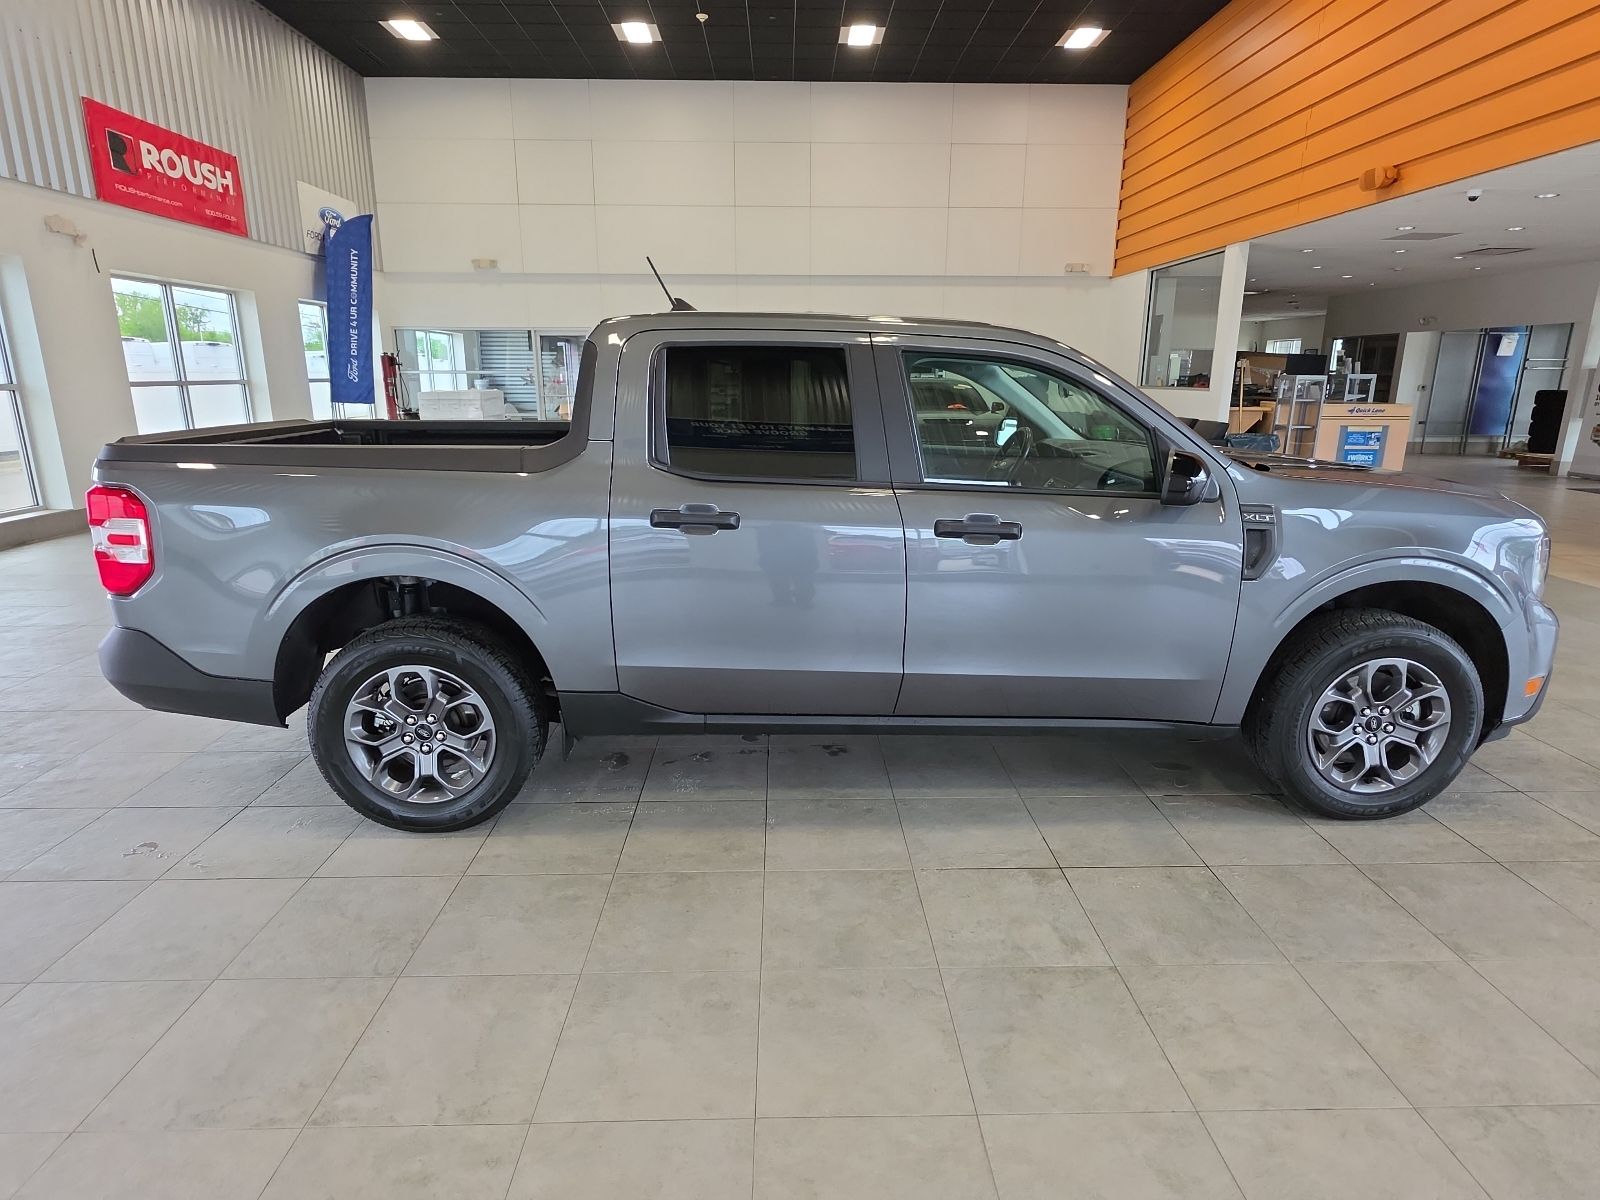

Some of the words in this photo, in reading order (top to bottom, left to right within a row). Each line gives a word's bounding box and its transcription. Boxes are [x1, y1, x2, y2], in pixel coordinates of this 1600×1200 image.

[139, 140, 234, 195] ROUSH
[324, 210, 341, 228] Ford
[350, 248, 359, 305] COMMUNITY
[350, 306, 358, 320] UR
[350, 328, 358, 356] DRIVE
[347, 358, 359, 383] Ford
[1243, 513, 1274, 521] XLT
